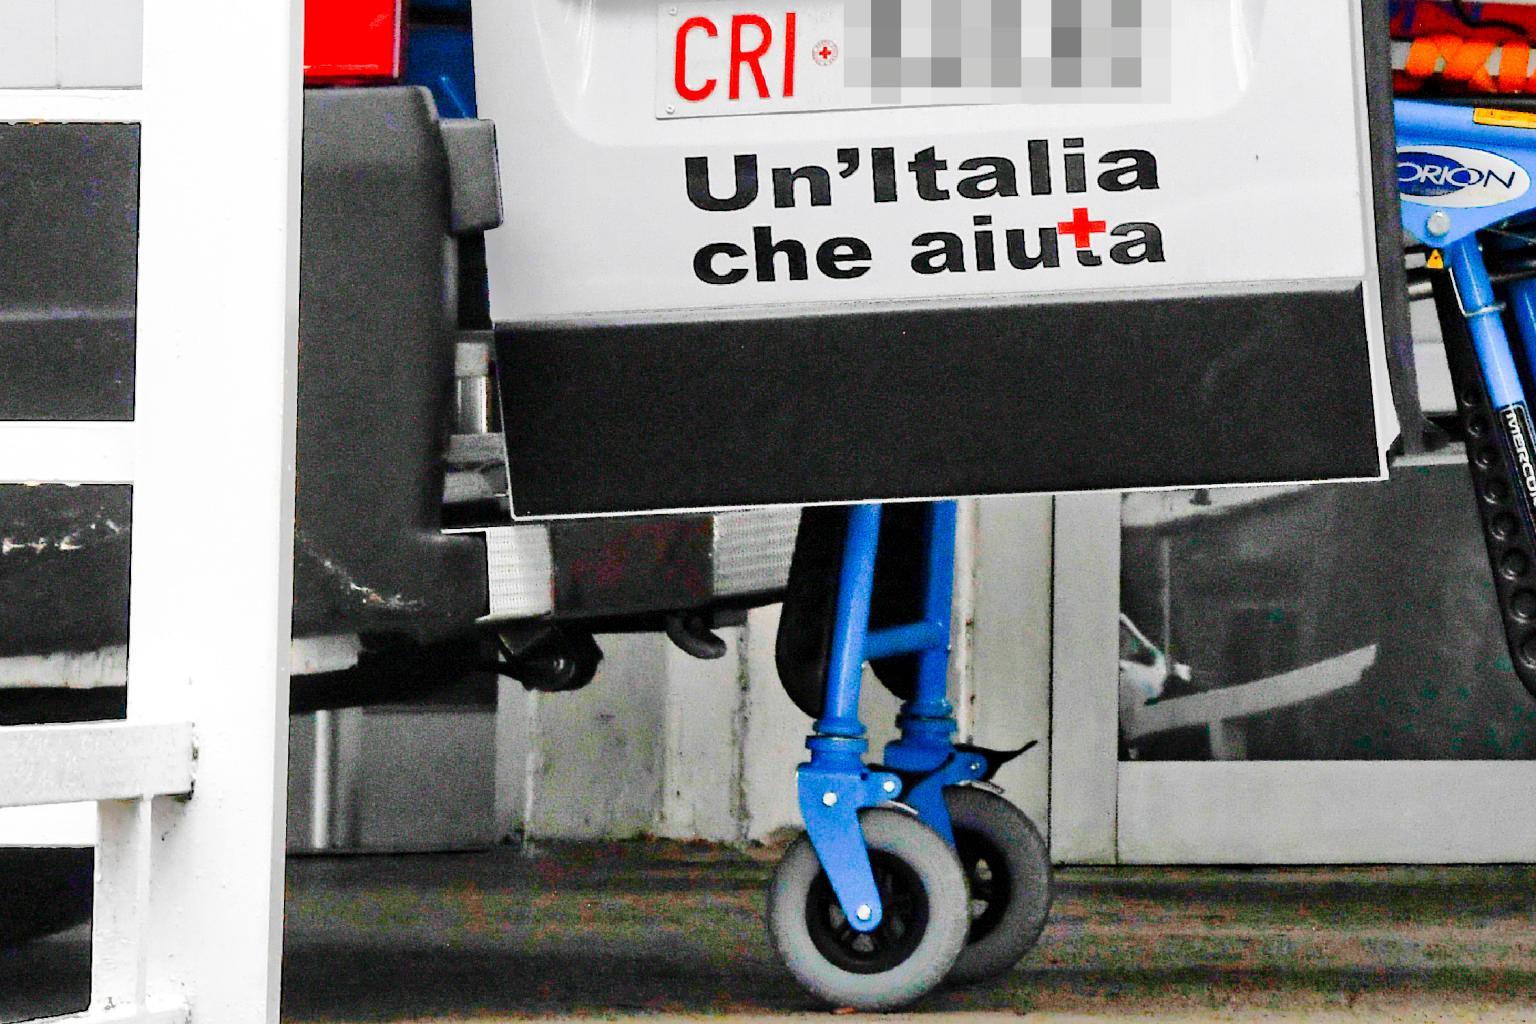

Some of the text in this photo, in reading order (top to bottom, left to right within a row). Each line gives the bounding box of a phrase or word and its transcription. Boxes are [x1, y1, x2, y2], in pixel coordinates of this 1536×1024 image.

[675, 13, 795, 101] CRI
[1397, 162, 1515, 189] ORION
[693, 208, 1166, 285] che aiuta
